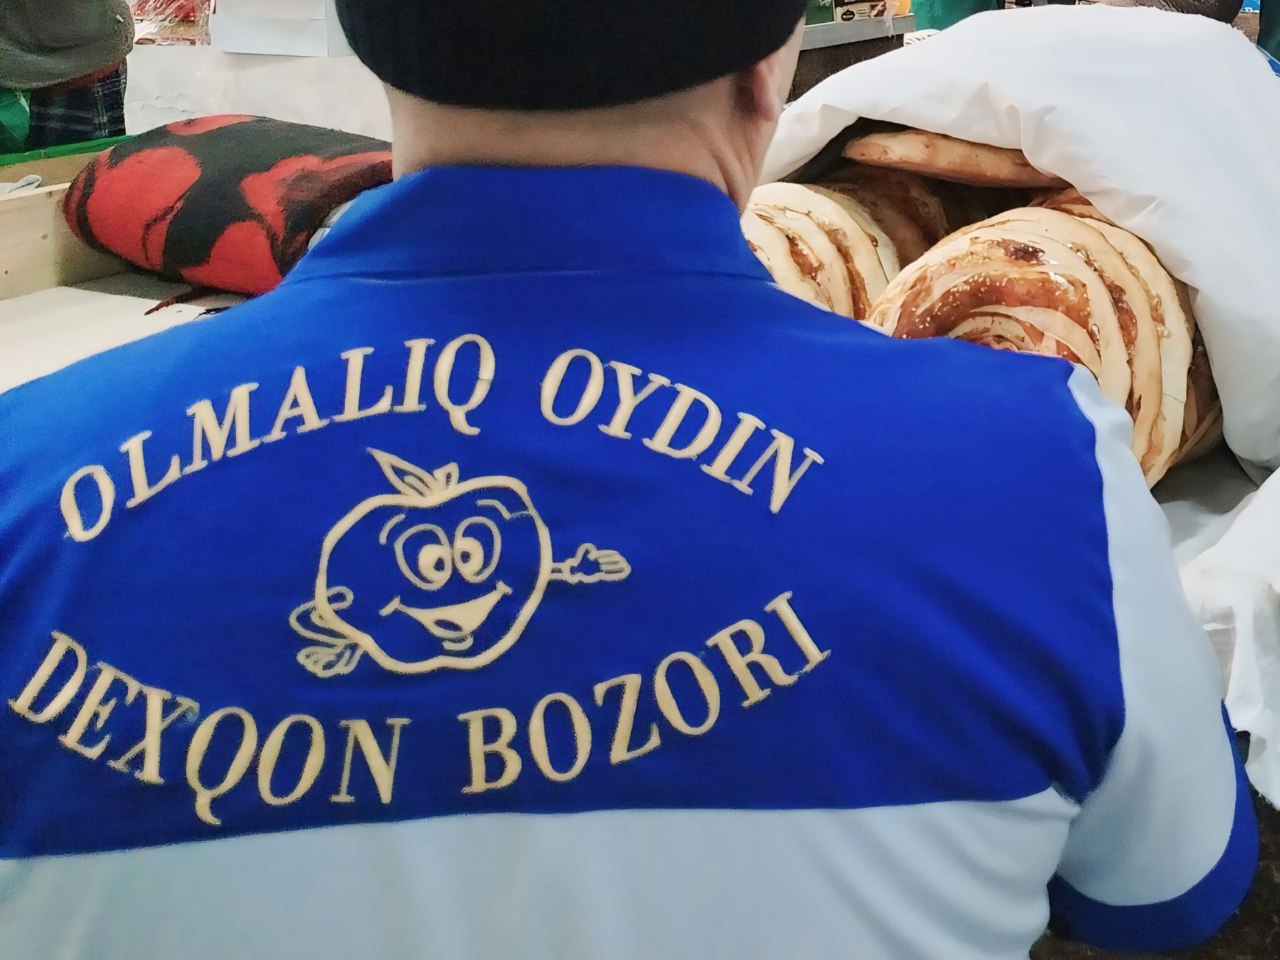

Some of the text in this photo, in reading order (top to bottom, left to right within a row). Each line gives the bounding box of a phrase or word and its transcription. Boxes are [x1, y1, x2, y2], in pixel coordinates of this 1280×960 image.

[60, 333, 825, 543] OLMALIQ OYDIN
[8, 591, 833, 827] DEXQON BOZORI
